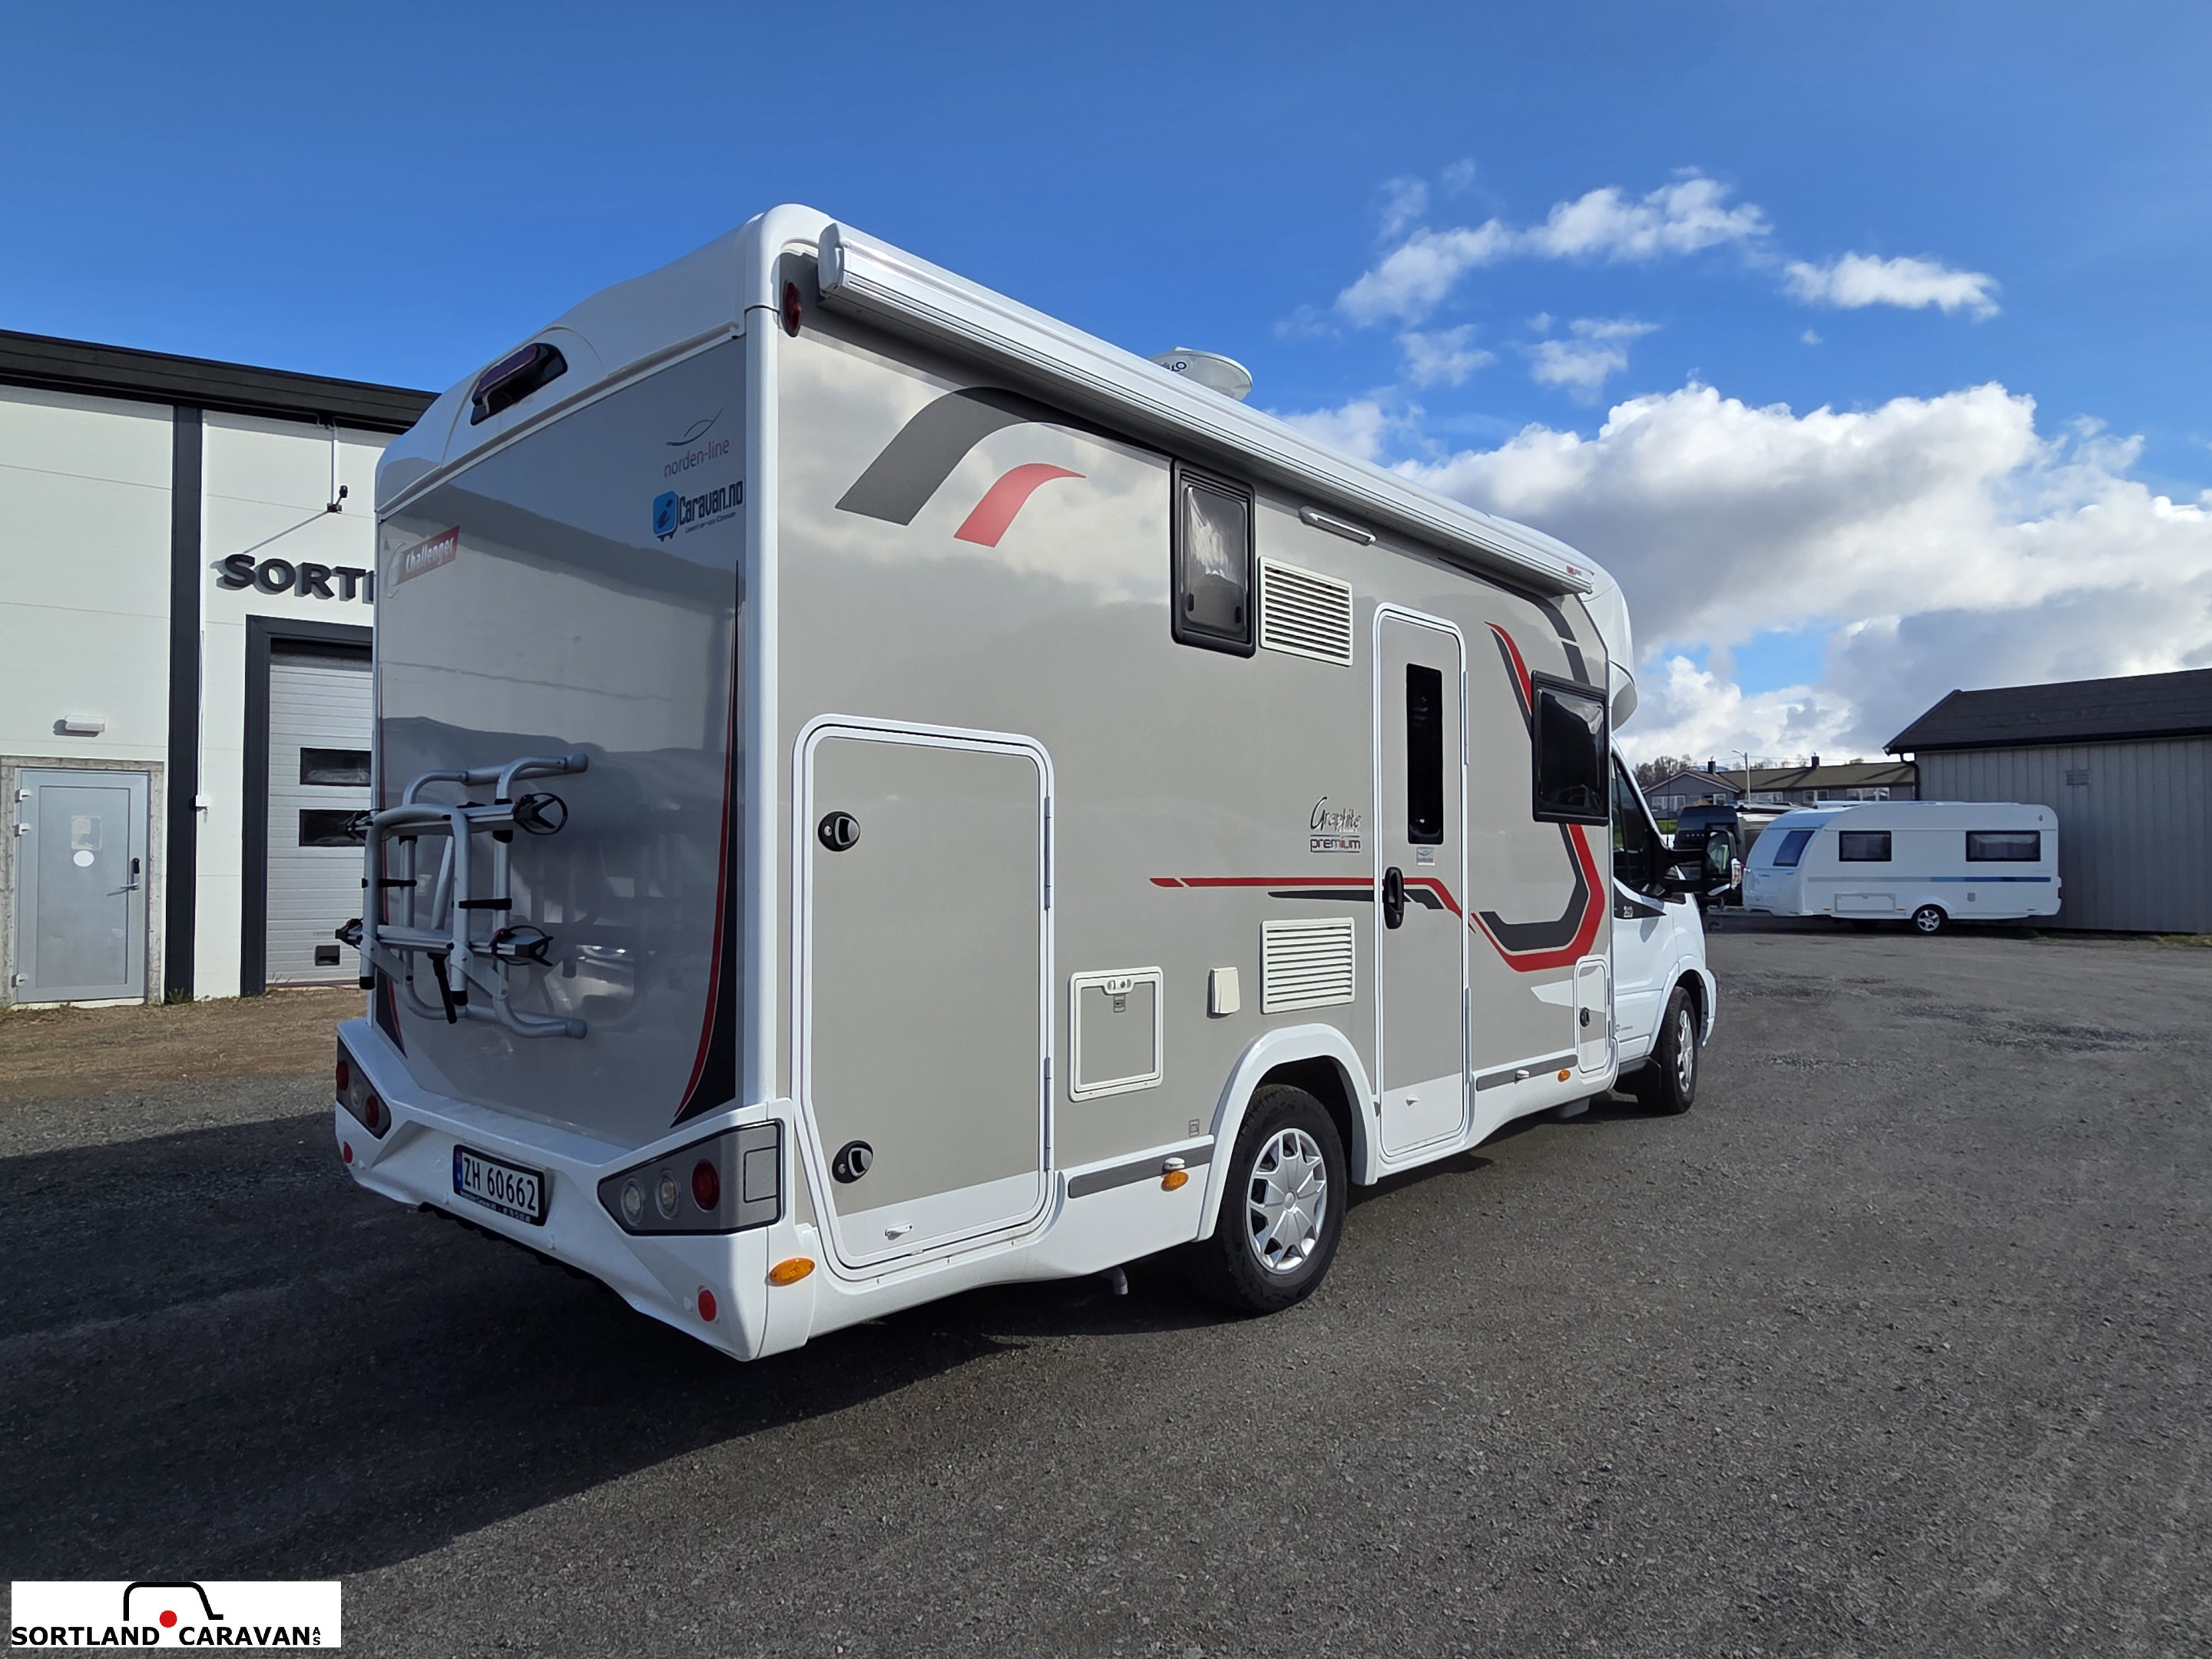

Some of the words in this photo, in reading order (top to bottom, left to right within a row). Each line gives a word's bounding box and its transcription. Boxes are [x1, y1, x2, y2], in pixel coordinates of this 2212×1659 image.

[664, 438, 730, 478] norden-line
[405, 536, 455, 574] Challenger
[1310, 796, 1363, 833] Graphite
[1310, 836, 1362, 853] premium
[463, 1157, 482, 1191] ZH
[486, 1167, 536, 1212] 60662
